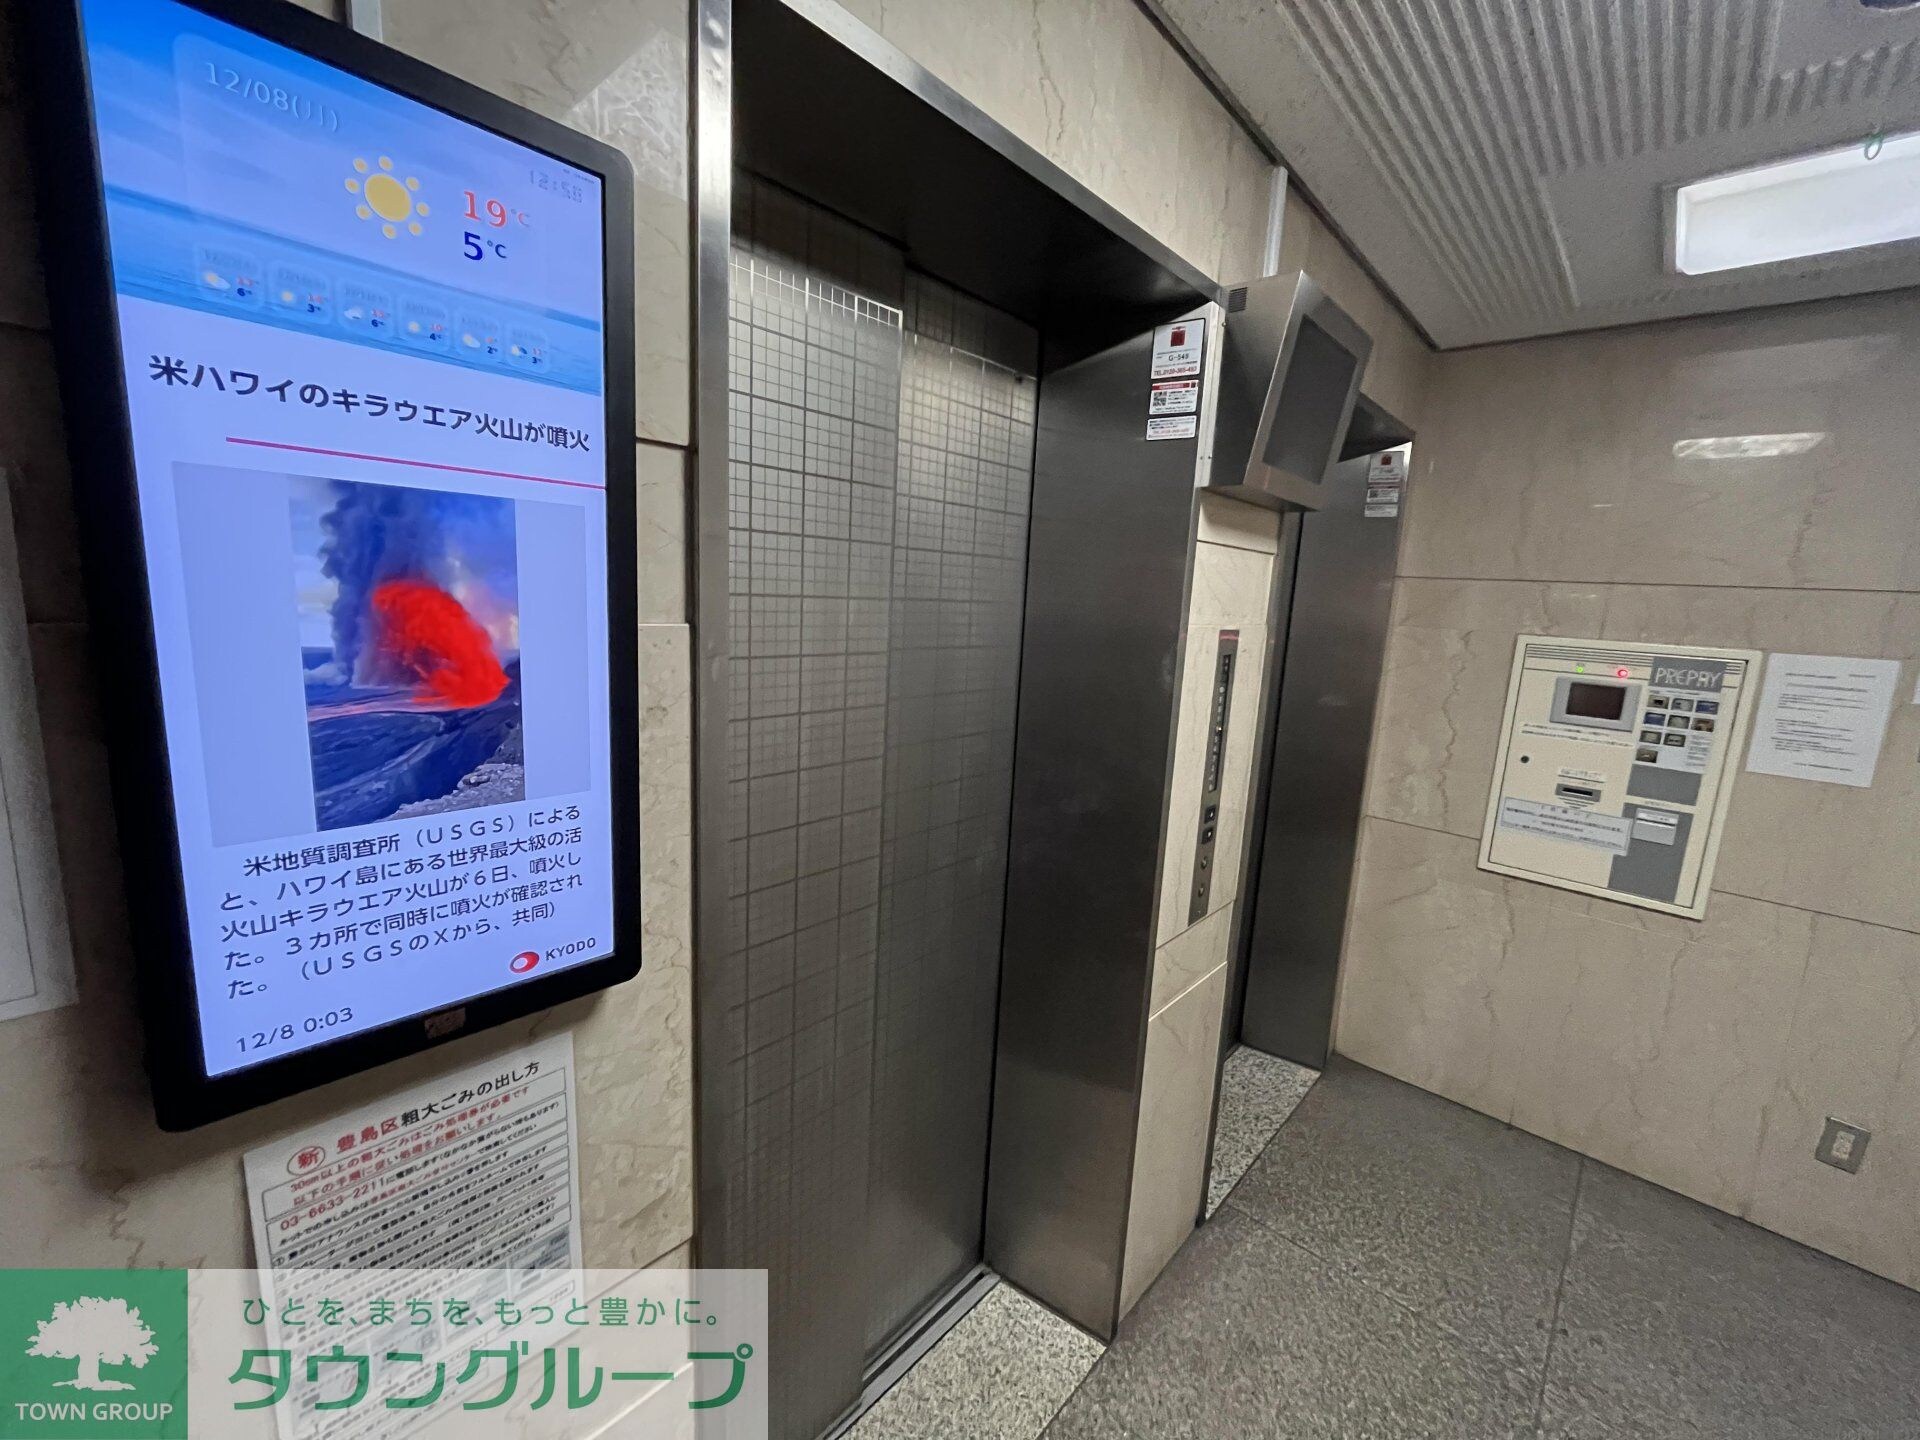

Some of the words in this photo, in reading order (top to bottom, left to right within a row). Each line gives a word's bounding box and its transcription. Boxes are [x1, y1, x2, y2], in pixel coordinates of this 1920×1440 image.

[149, 354, 590, 453] 米ハワイのキラウエア火山が噴火
[1655, 666, 1723, 688] PREPAY
[218, 827, 582, 912] と、ハワイ島にある世界最大級の活
[220, 852, 582, 943] 火山キラウエア火山が6日、噴火し
[545, 936, 597, 962] KYODO
[236, 1023, 295, 1053] 12/8
[303, 1006, 354, 1033] 0:03
